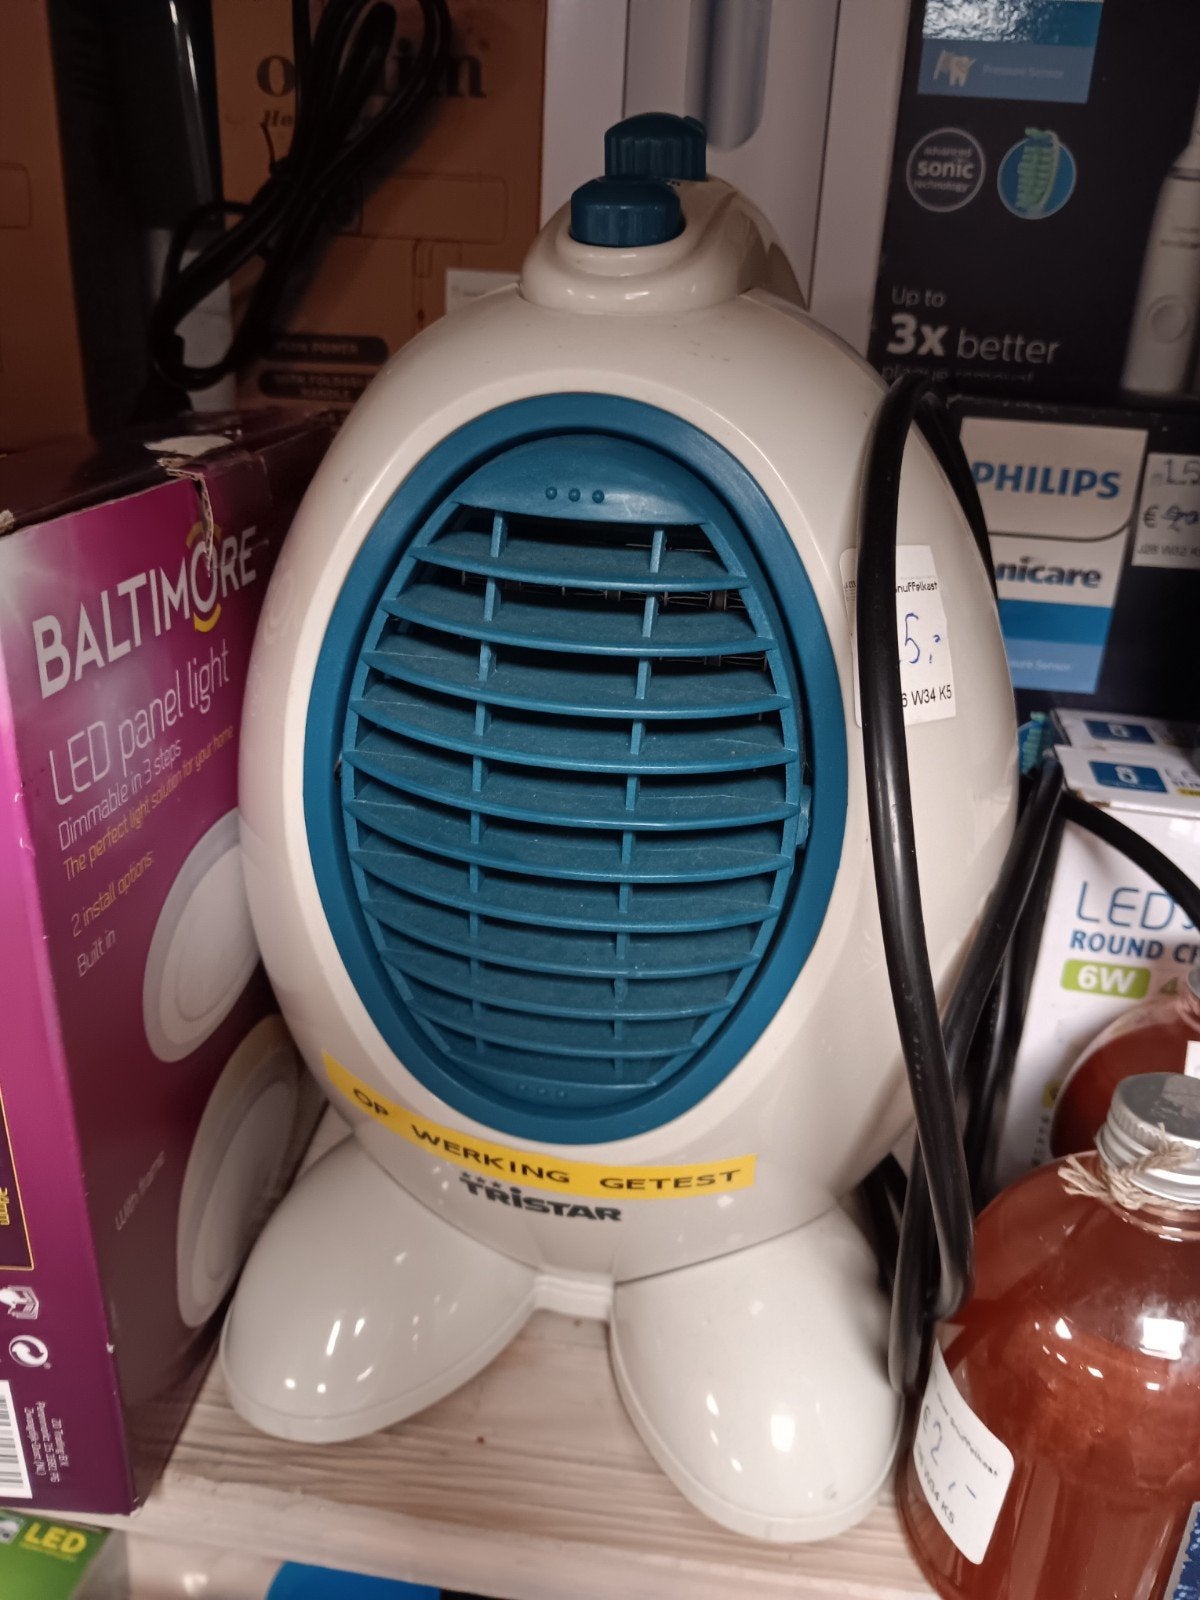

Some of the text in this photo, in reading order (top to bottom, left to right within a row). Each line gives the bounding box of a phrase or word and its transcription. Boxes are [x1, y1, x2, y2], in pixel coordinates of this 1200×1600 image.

[917, 158, 975, 180] sonic
[891, 286, 946, 308] Up to
[888, 313, 1060, 364] 3x better
[972, 461, 1121, 499] PHILIPS
[896, 581, 938, 593] nuffelkast
[995, 556, 1101, 588] nicare
[32, 526, 256, 699] BALTIMORE
[911, 687, 936, 706] W34
[939, 684, 952, 701] K5
[50, 638, 229, 805] LED panel light
[58, 739, 181, 851] Dimmable in 3 steps
[63, 854, 86, 882] The
[88, 817, 129, 868] perfect
[151, 770, 183, 809] solution
[195, 743, 214, 772] your
[71, 913, 82, 938] 2
[83, 881, 116, 927] install
[77, 930, 116, 977] Built in
[1070, 930, 1164, 959] ROUND
[1077, 965, 1137, 994] 6W
[352, 1087, 741, 1190] OP WERKING GETEST
[24, 1522, 88, 1554] LED
